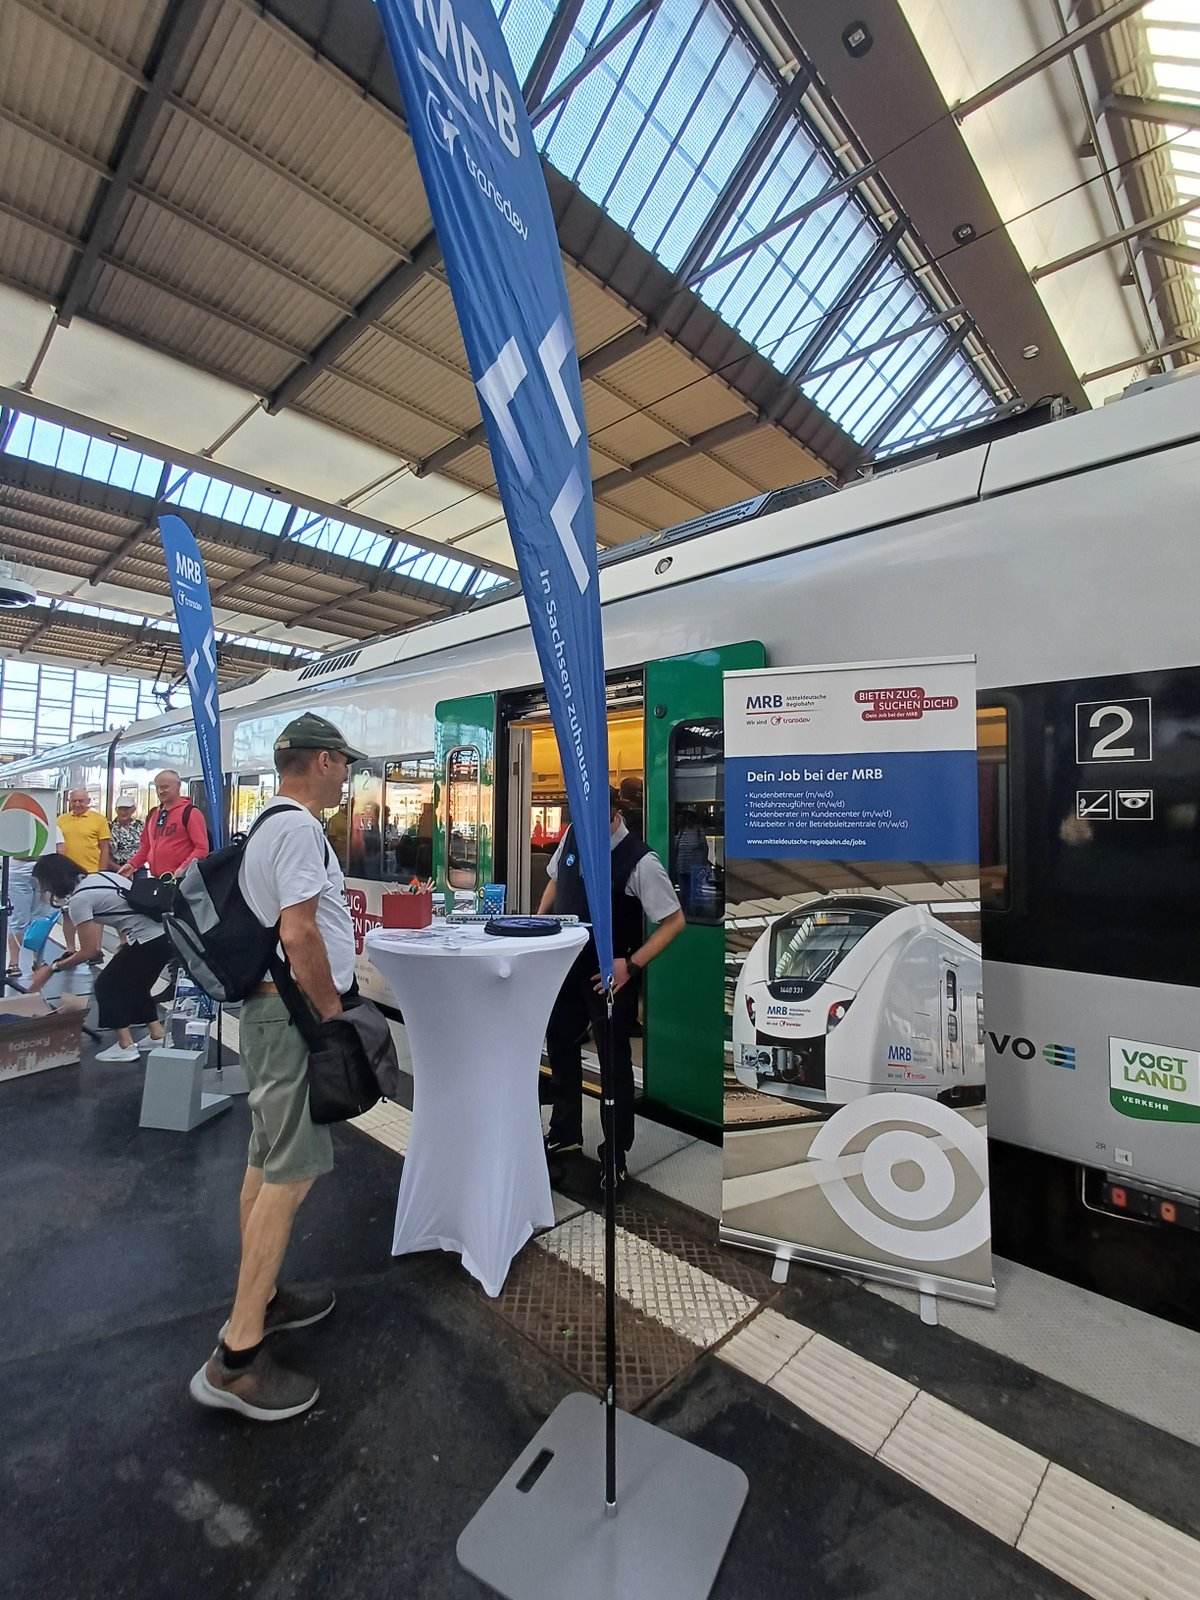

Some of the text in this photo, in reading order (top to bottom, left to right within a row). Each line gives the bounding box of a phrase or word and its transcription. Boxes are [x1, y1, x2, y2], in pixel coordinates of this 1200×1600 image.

[413, 0, 520, 158] MRB
[463, 144, 528, 241] transdev
[175, 551, 201, 585] MRB
[539, 568, 591, 802] In Sachsen zuhause.
[746, 694, 783, 709] MRB
[859, 689, 920, 701] BIETEN ZUG,
[879, 699, 953, 710] SUCHEN DICH!
[1089, 705, 1135, 758] 2
[747, 768, 883, 782] Dein Job bei der MRB
[749, 790, 834, 799] Kundenbetreuer (m/w/d)
[749, 800, 845, 809] Triebfahrzeugführer (m/w/d)
[811, 810, 860, 818] Kundencenter
[861, 810, 892, 818] (m/w/d)
[749, 819, 909, 829] Mitarbeiter in der Betriebsleitzentrale (m/w/d)
[746, 838, 867, 847] www.mitteldeutsche-regiobahn.de/jobs
[767, 1005, 788, 1015] MRB
[888, 1045, 912, 1061] MRB
[984, 1031, 1036, 1060] VO
[1121, 1048, 1188, 1075] VOGT
[1124, 1065, 1187, 1092] LAND
[1122, 1095, 1169, 1112] VERKEHR
